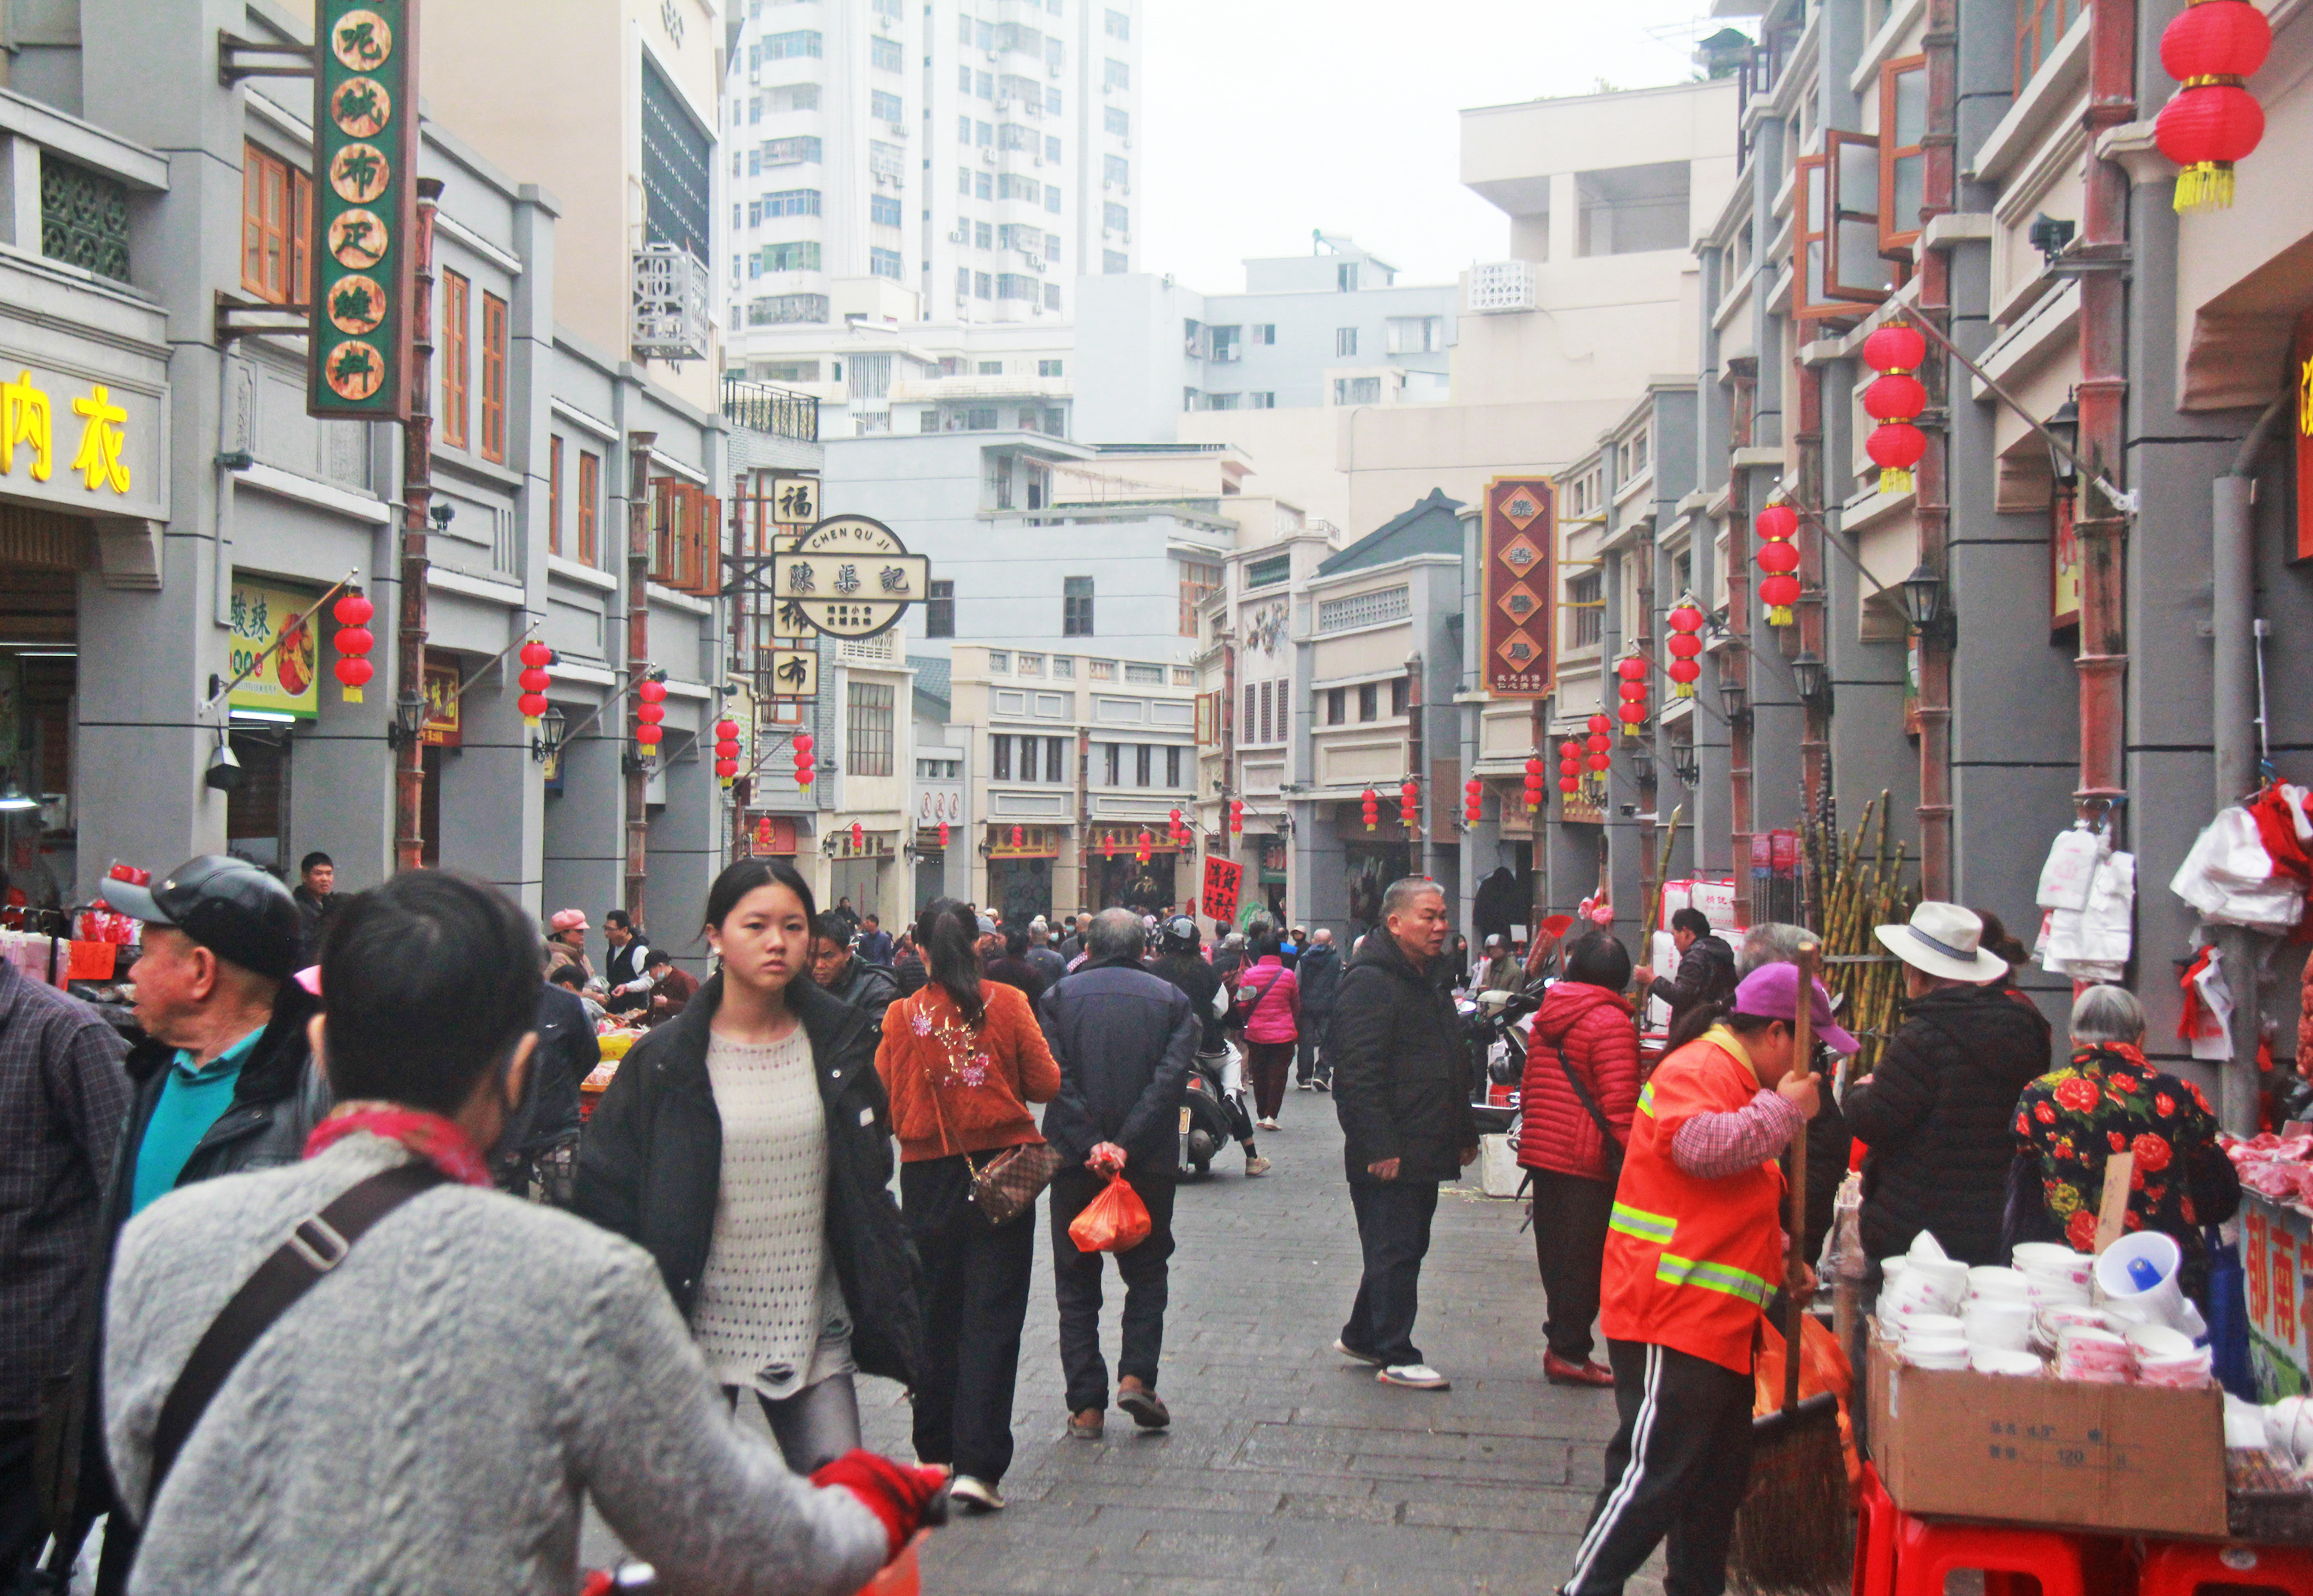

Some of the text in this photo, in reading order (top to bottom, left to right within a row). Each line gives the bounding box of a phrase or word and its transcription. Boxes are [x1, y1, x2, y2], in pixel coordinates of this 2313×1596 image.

[0, 370, 130, 493] 内衣
[813, 528, 889, 550] CHEN QU JI
[789, 562, 909, 594] 陳渠記
[231, 590, 271, 644] 酸辣
[2245, 1207, 2313, 1348] 郁南
